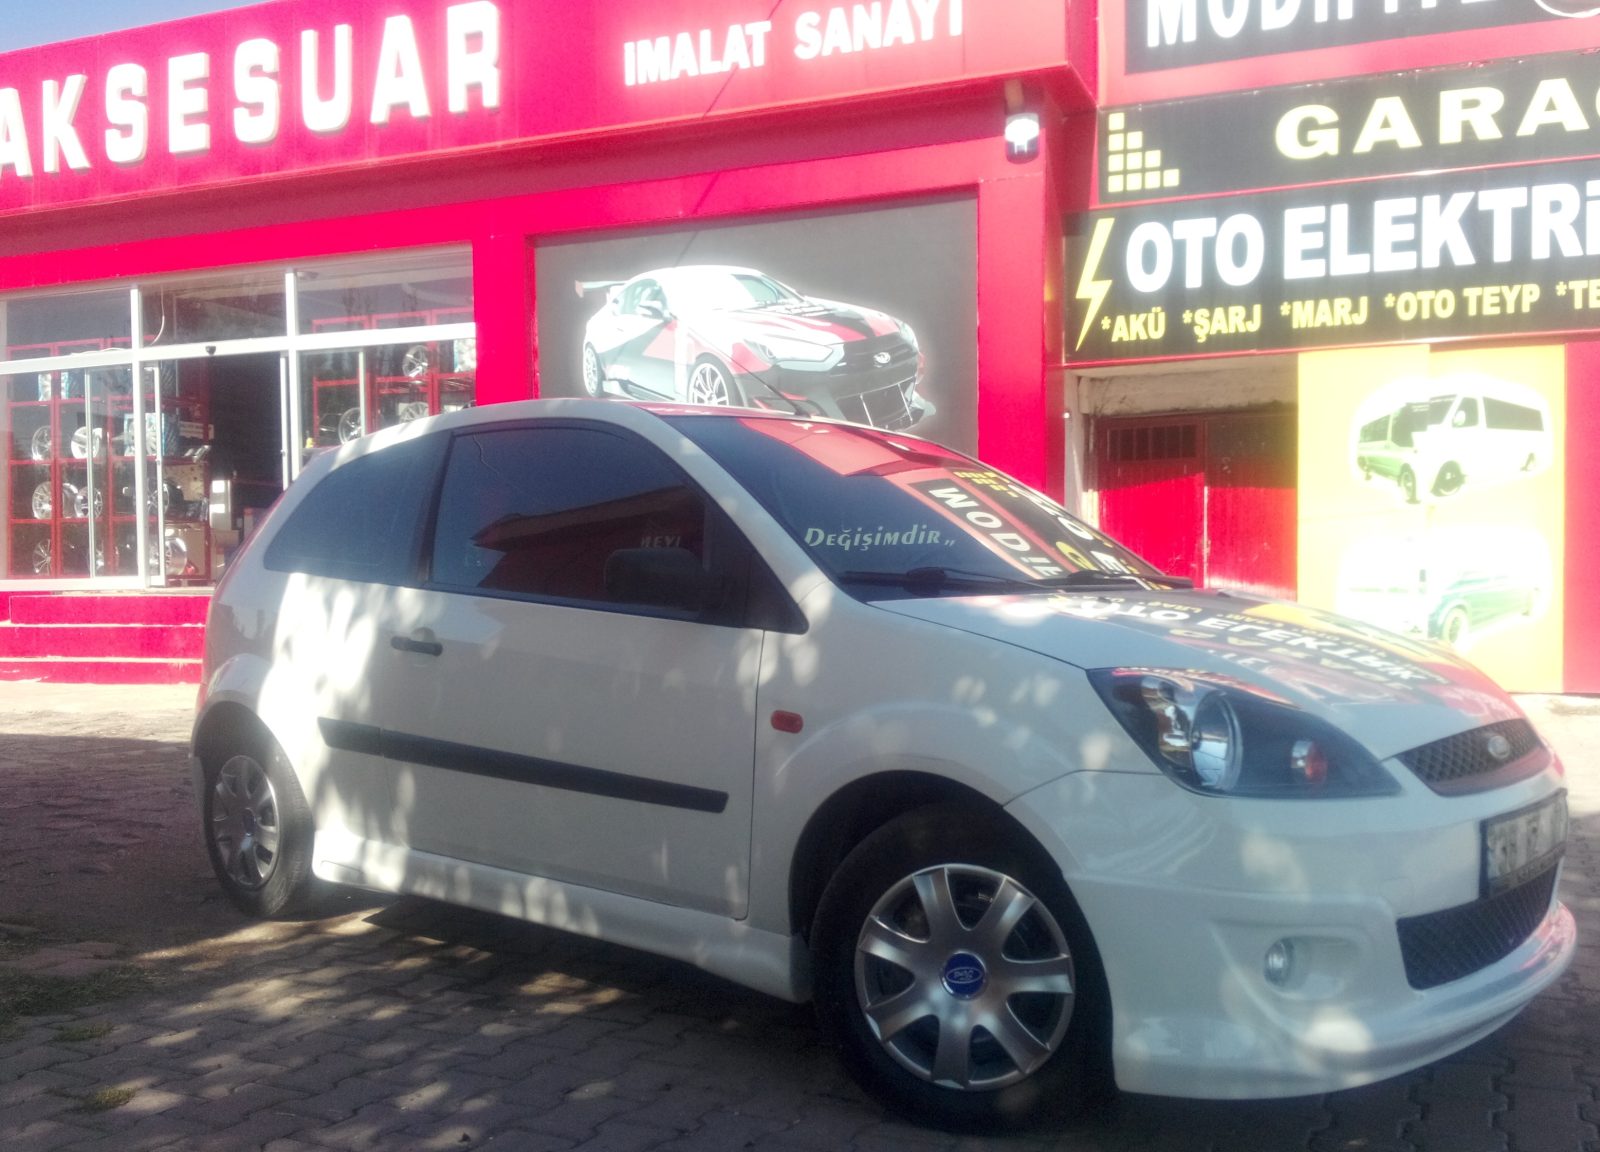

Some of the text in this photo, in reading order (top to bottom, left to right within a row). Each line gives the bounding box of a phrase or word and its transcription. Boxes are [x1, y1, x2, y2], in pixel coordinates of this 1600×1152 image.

[0, 0, 500, 178] AKSESUAR
[623, 19, 772, 86] IMALAT
[1274, 77, 1600, 160] GARA
[1125, 212, 1265, 293] OTO
[1463, 282, 1541, 316] TEYP
